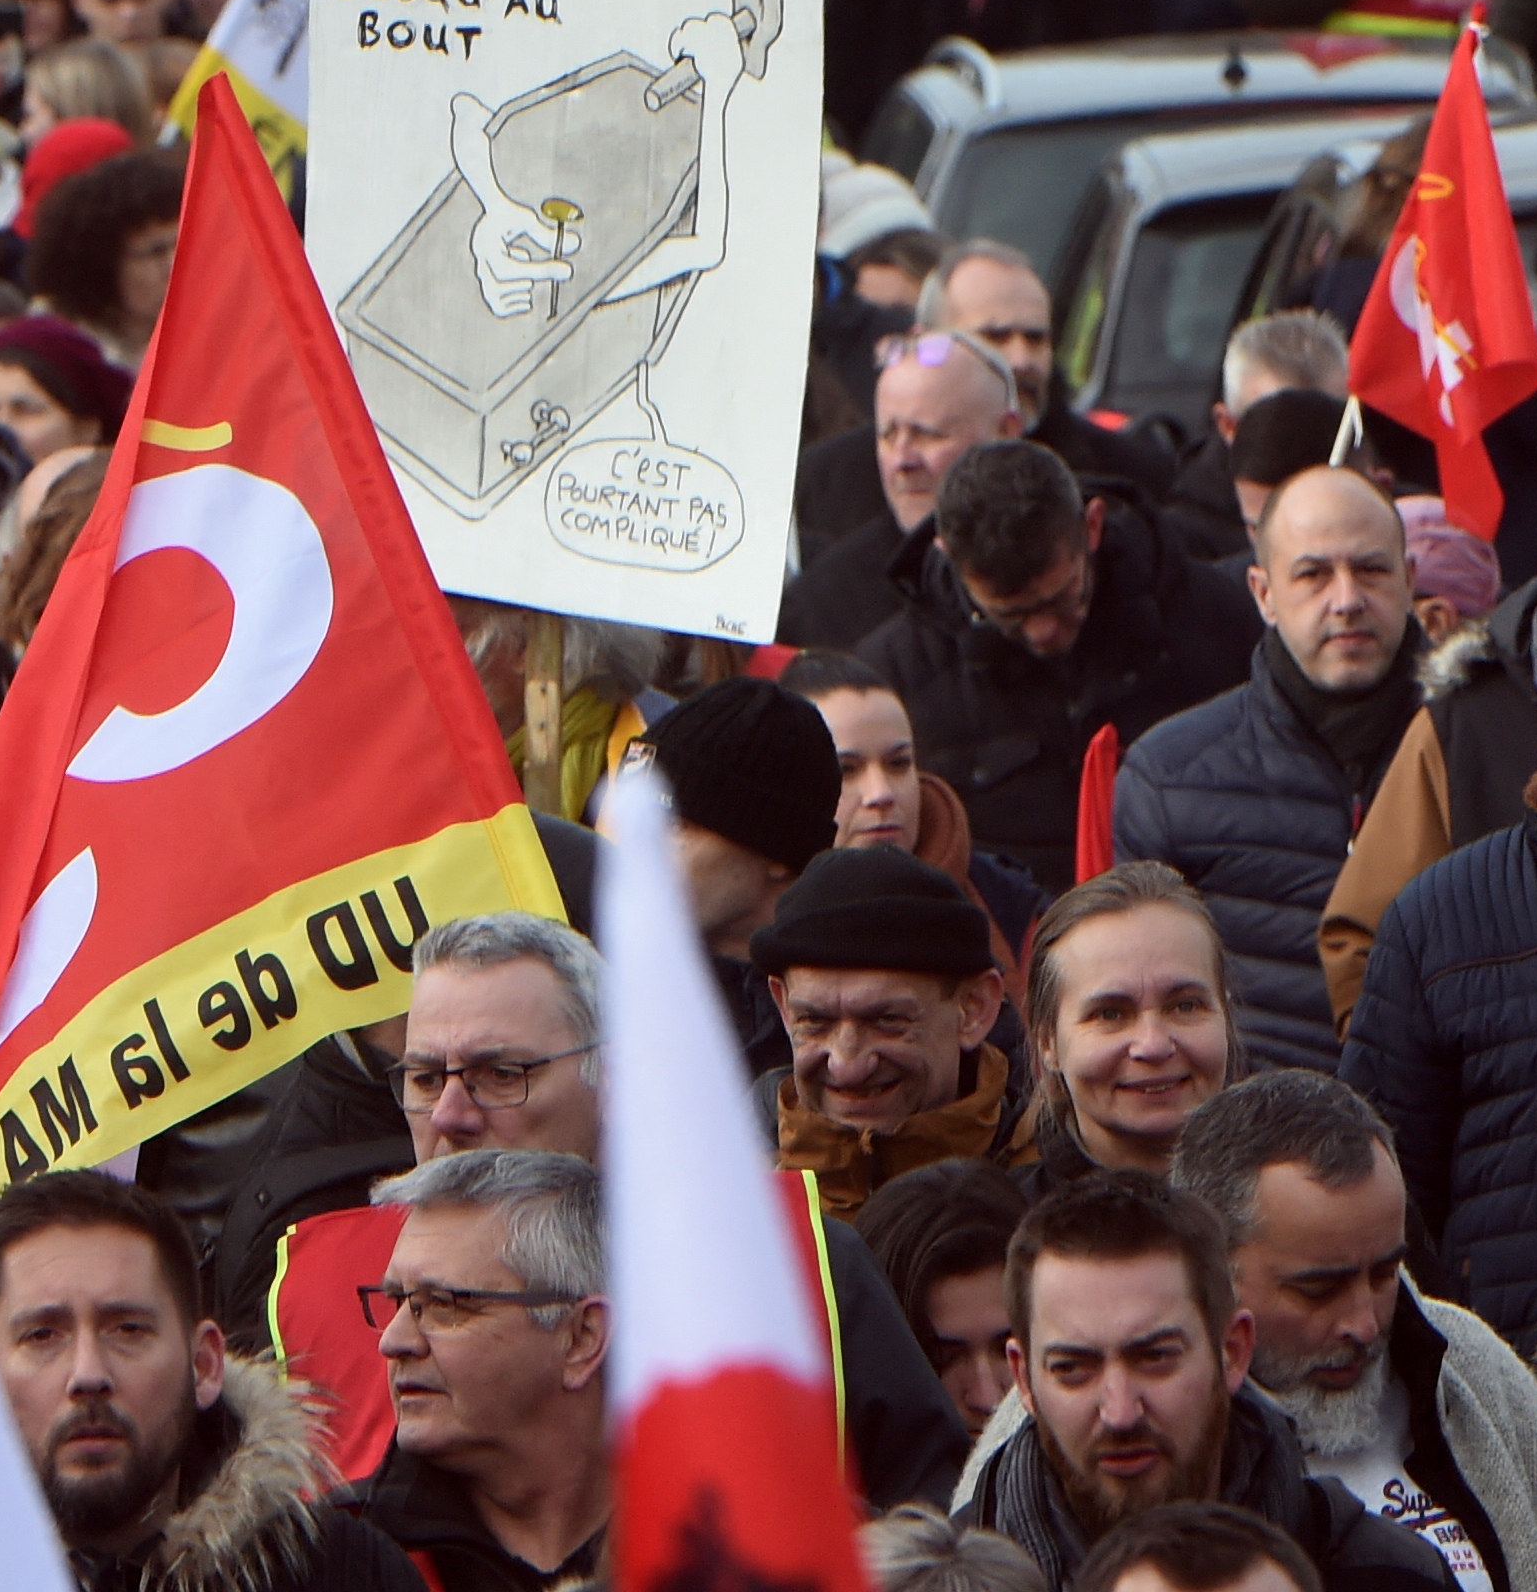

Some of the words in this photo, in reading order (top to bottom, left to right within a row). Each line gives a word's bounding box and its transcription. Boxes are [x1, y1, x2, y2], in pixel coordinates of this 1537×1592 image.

[357, 9, 482, 61] BOUT
[557, 472, 680, 519] POURTANT
[689, 496, 728, 529] PAS
